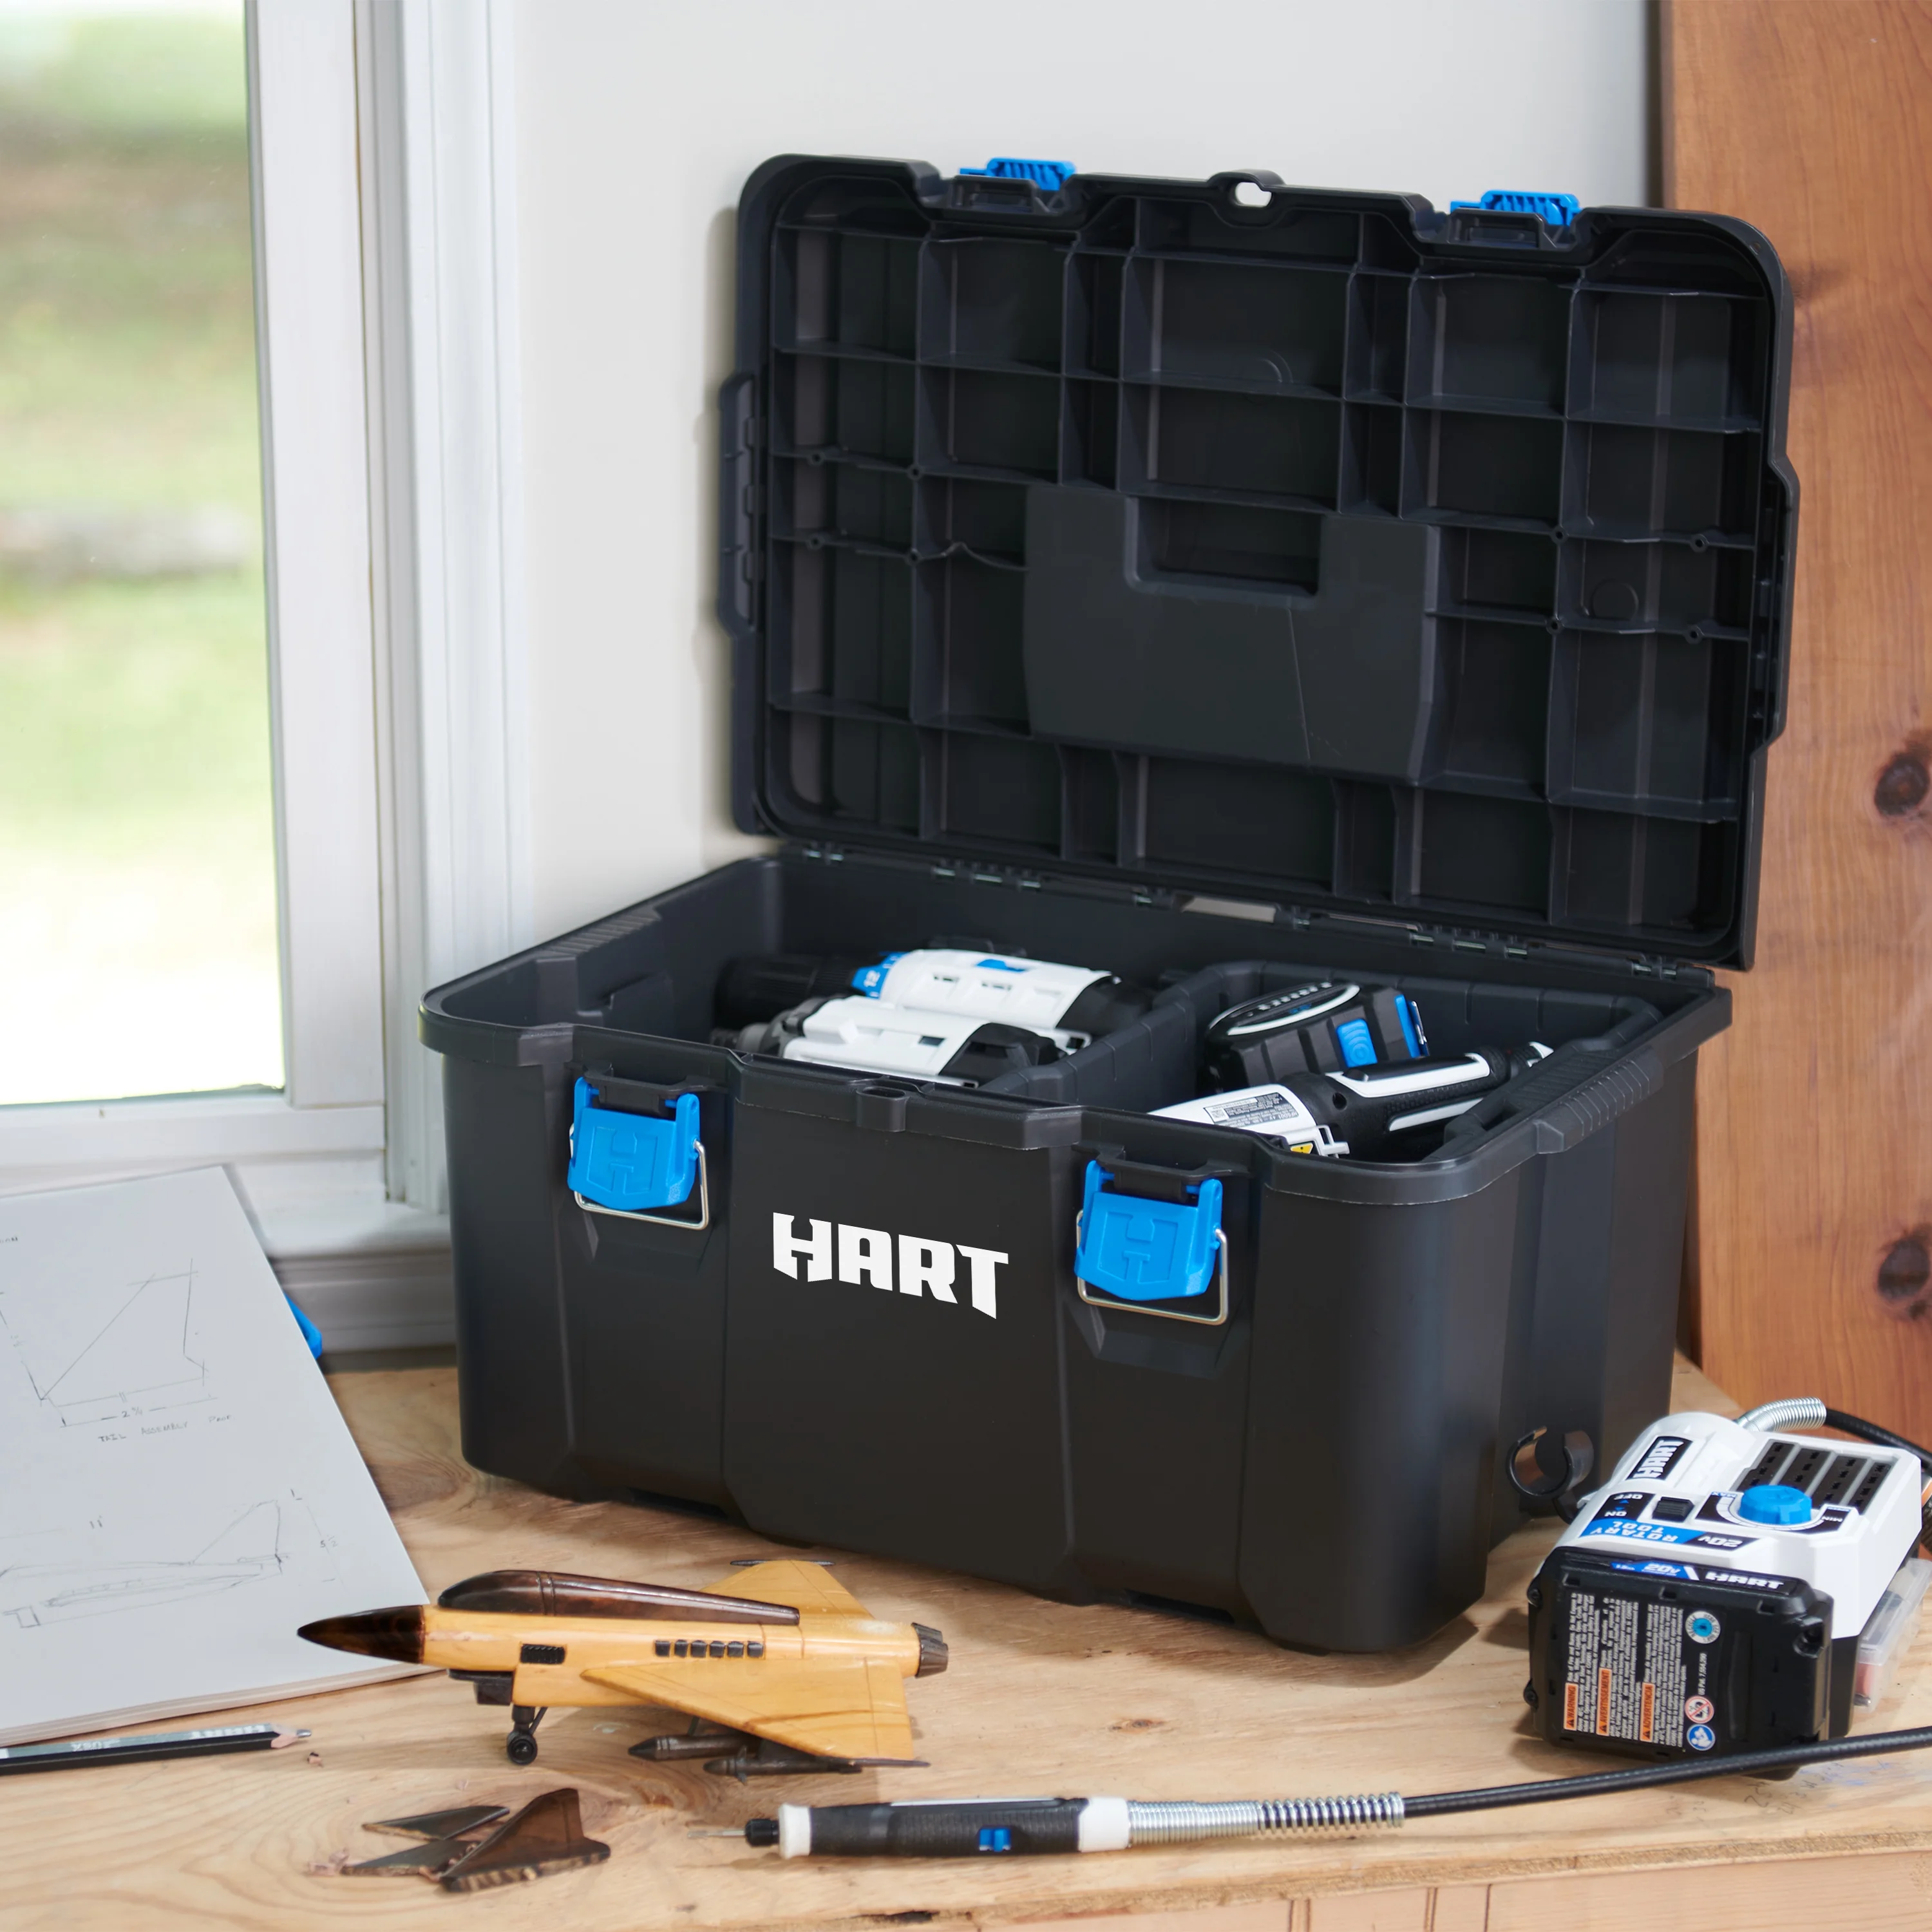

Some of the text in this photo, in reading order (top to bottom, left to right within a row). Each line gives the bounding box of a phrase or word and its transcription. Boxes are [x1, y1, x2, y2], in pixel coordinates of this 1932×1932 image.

[773, 1212, 1009, 1320] HART
[1633, 1440, 1684, 1478] HART
[1590, 1527, 1679, 1542] ROTARY
[1612, 1521, 1665, 1534] TOOL
[1705, 1571, 1784, 1589] HART
[1566, 1687, 1577, 1718] WARNING
[1600, 1671, 1609, 1723] AVERTISSEMENT
[1643, 1686, 1653, 1728] ADVERTENCIA
